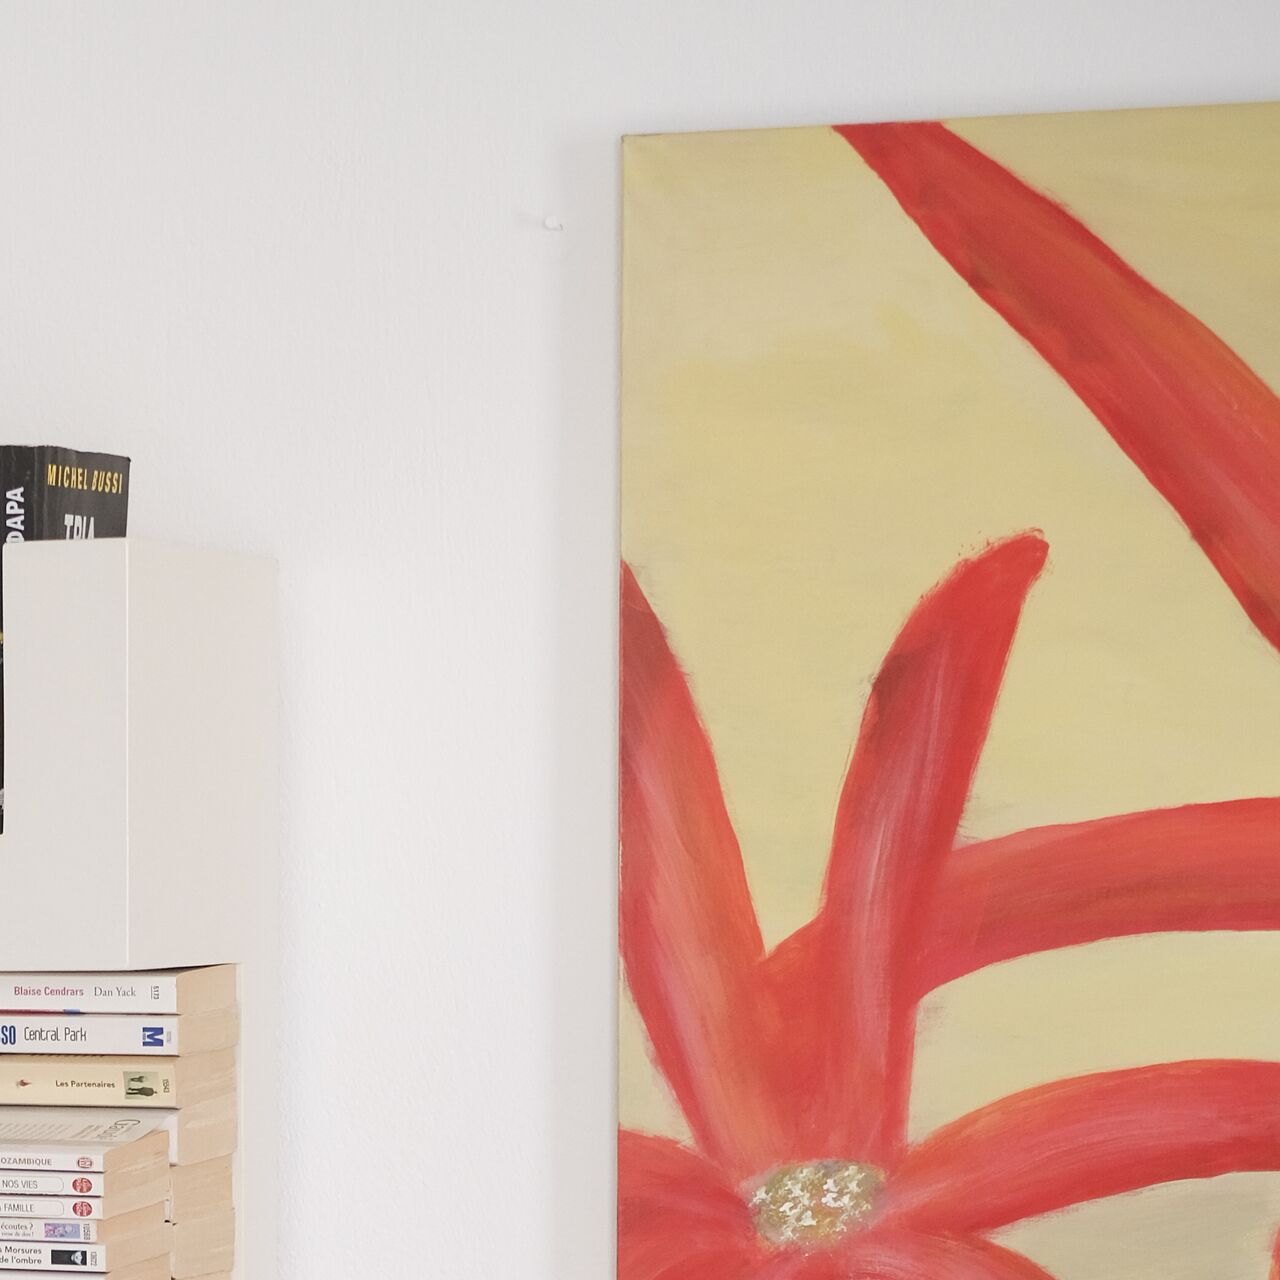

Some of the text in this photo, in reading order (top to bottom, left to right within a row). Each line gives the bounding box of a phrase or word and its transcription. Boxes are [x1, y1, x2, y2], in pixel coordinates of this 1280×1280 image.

[48, 464, 122, 494] MICHEL BUSSI
[14, 986, 136, 997] Blaise Cendrars Dan Yack
[24, 1027, 60, 1042] Central
[64, 1027, 87, 1042] Park
[71, 1080, 115, 1089] Partenaires
